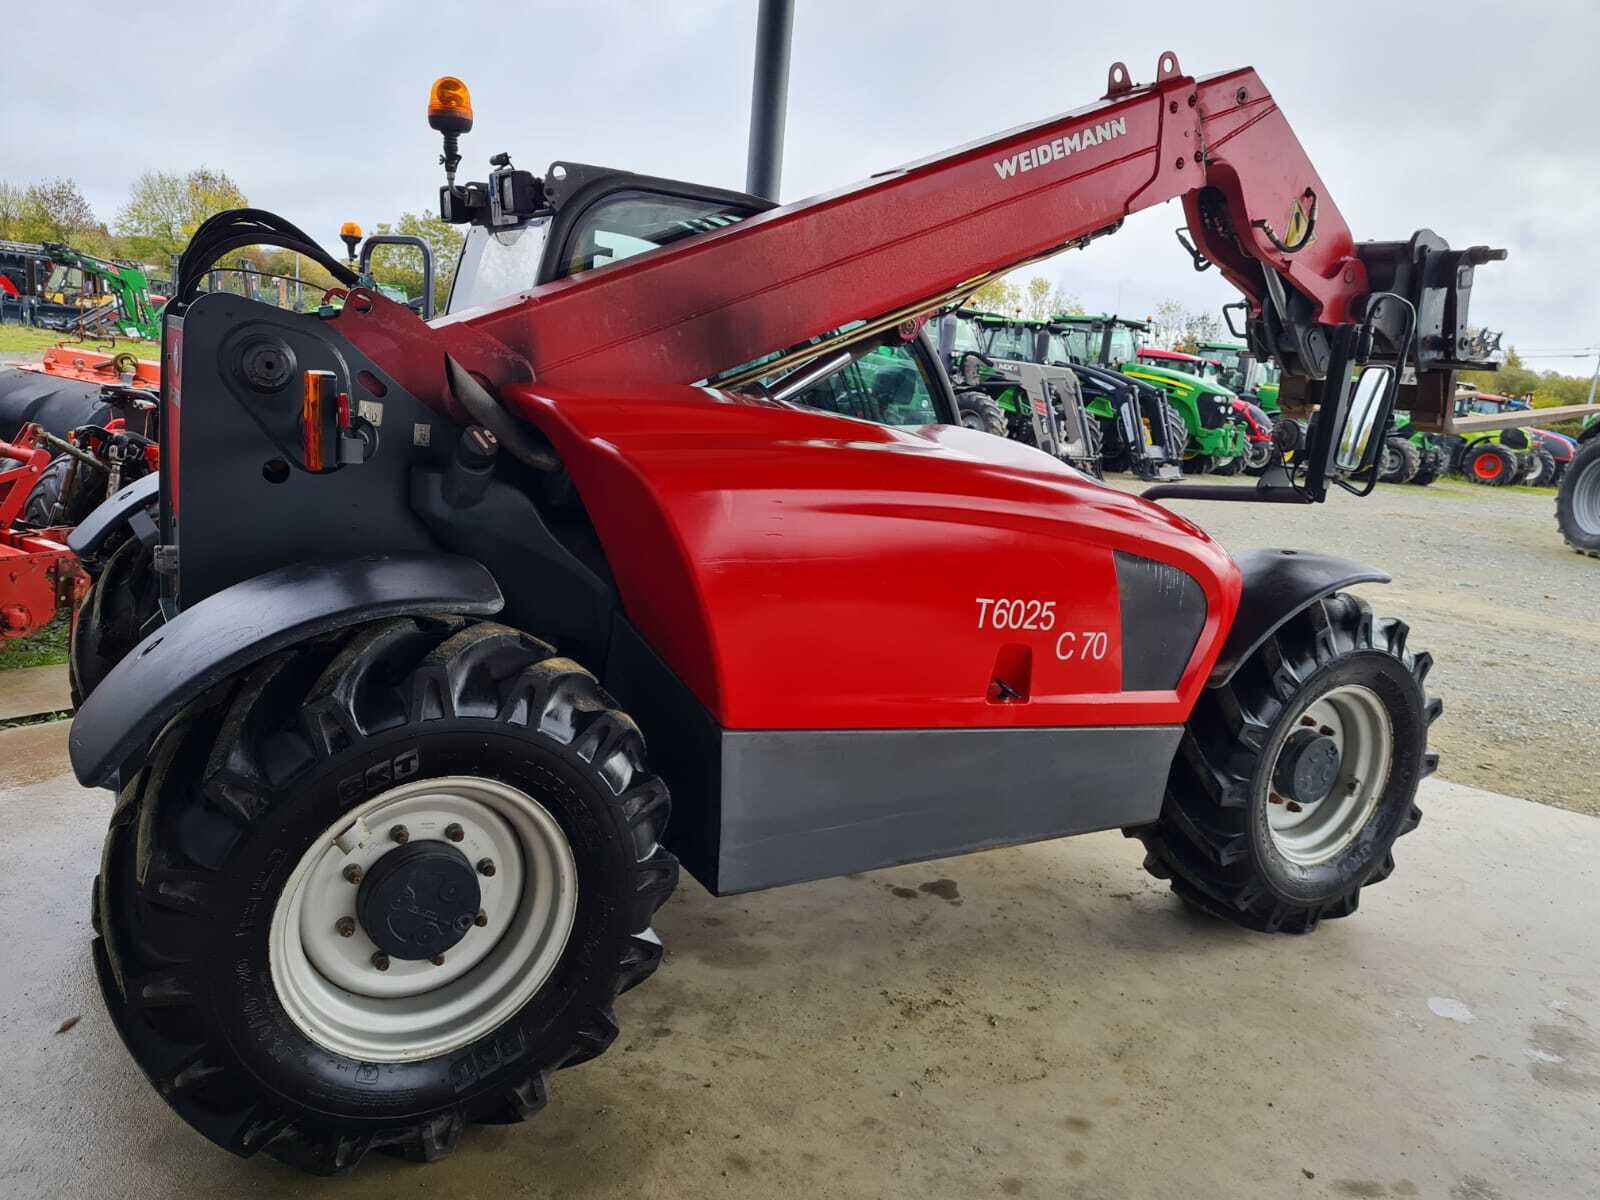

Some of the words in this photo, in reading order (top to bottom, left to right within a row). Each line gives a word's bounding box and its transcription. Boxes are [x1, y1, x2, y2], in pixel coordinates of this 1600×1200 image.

[993, 116, 1127, 180] WEIDEMANN
[975, 597, 1057, 631] T6025
[1055, 631, 1076, 661] C
[1080, 631, 1108, 660] 70
